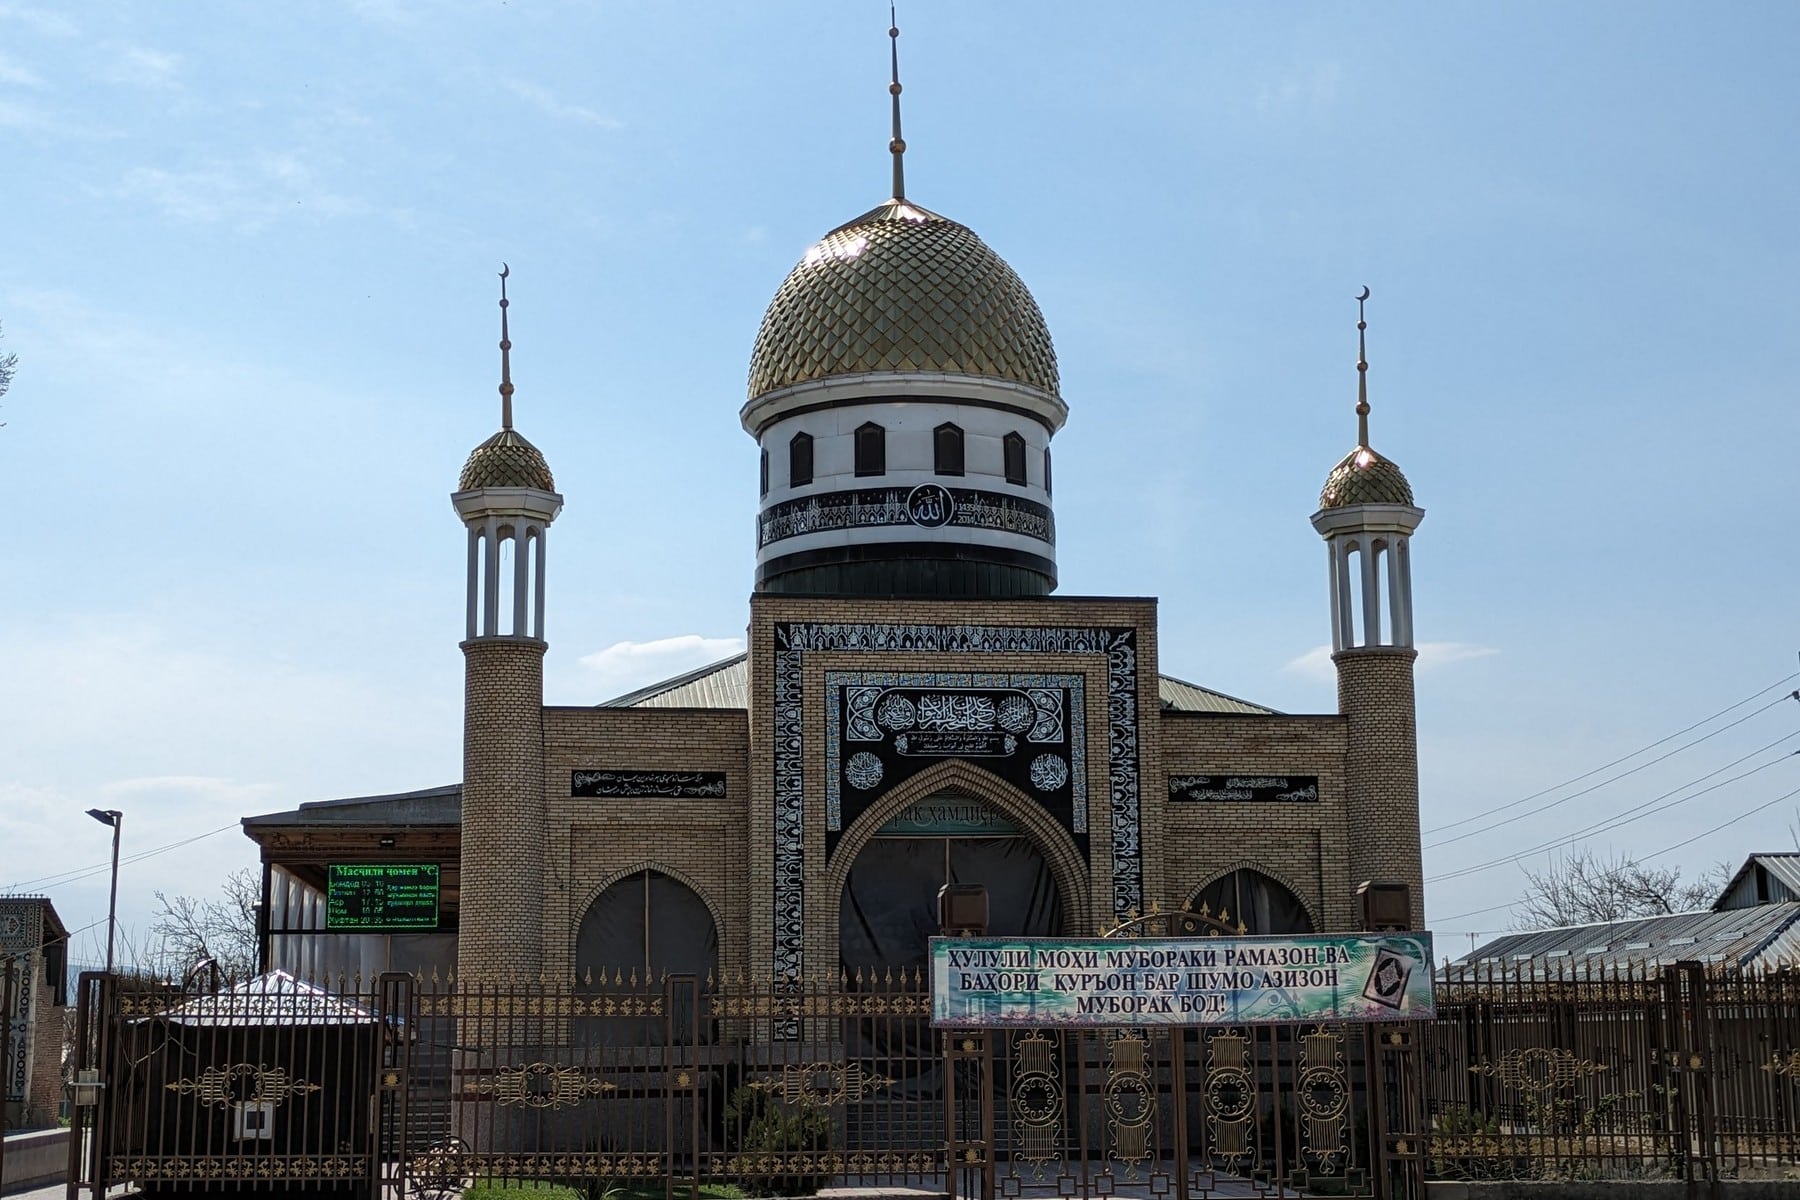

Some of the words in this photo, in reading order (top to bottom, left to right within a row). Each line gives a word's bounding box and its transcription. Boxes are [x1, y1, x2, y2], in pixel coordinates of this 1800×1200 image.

[948, 950, 1030, 970] ҲУЛУЛИ
[1037, 950, 1099, 971] МОҲИ
[1106, 949, 1216, 969] МУБОРАКИ
[1225, 947, 1318, 966] РАМАЗОН
[1323, 946, 1350, 964] ВА
[959, 973, 1041, 993] БАҲОРИ
[1053, 973, 1137, 993] ҚУРЪОН
[1144, 973, 1180, 991] БАР
[1187, 971, 1254, 990] ШУМО
[1260, 969, 1339, 988] АЗИЗОН
[1076, 996, 1172, 1014] МУБОРАК
[1180, 994, 1226, 1013] БОД!
